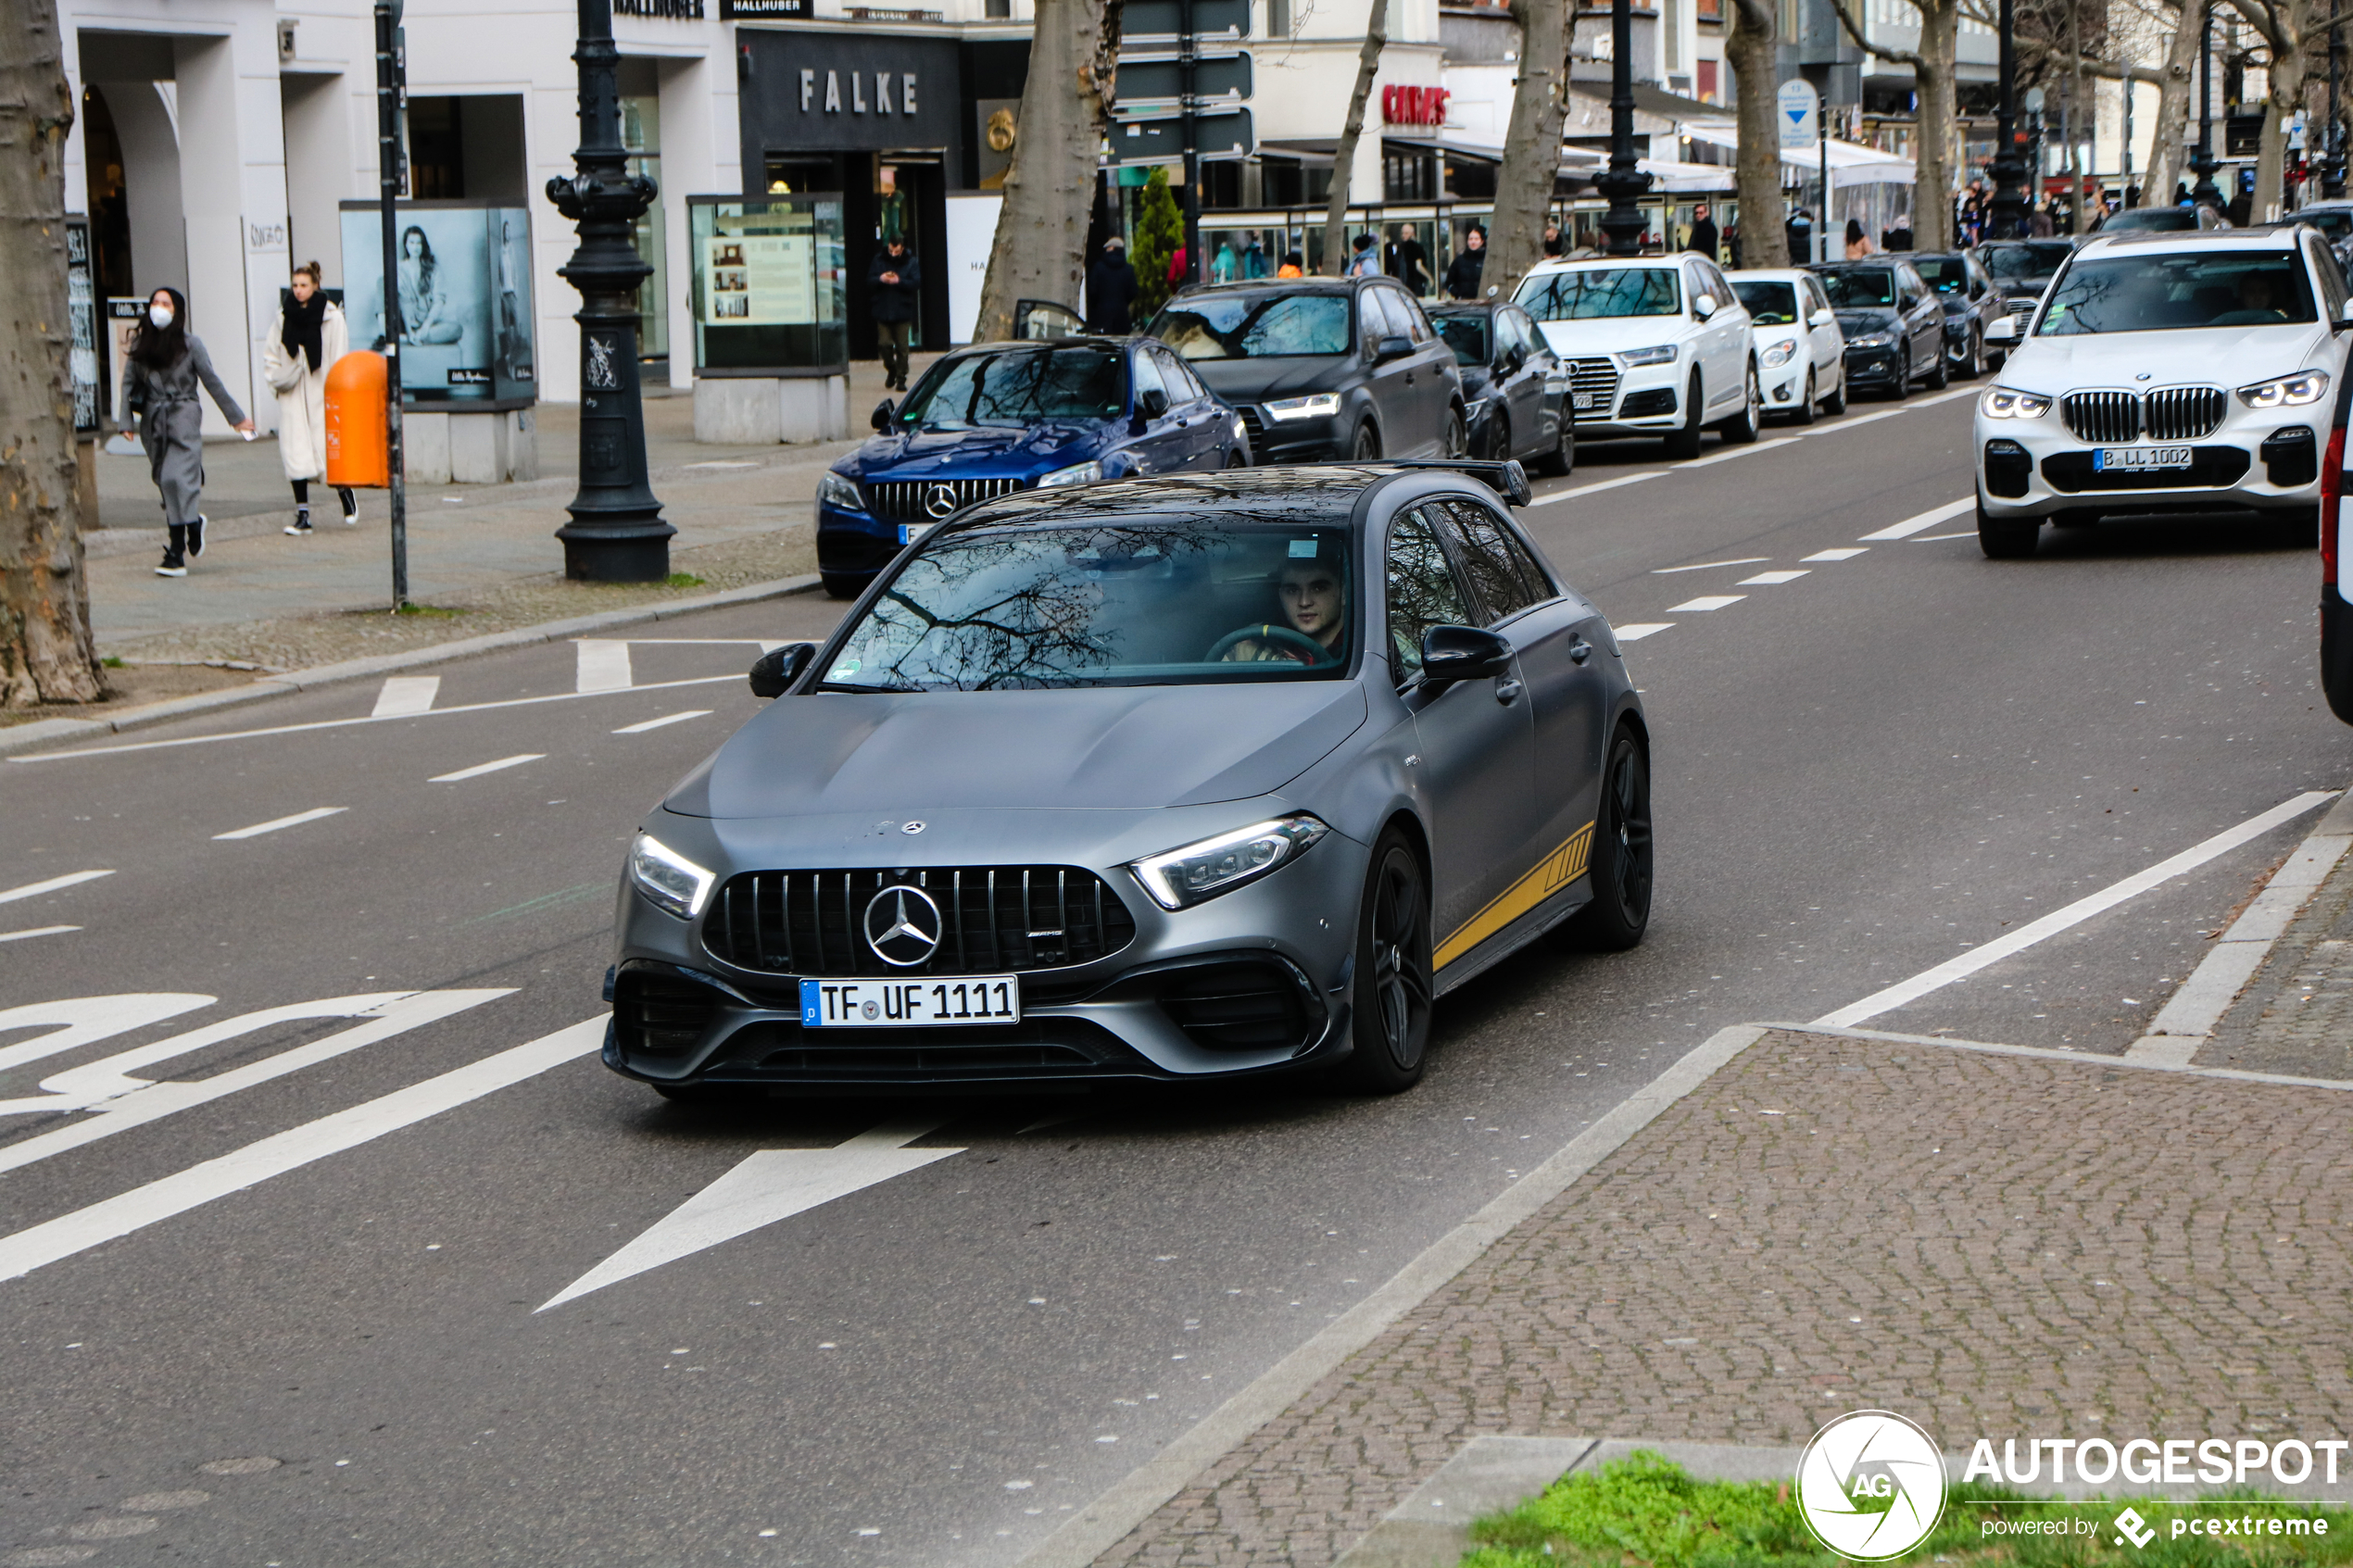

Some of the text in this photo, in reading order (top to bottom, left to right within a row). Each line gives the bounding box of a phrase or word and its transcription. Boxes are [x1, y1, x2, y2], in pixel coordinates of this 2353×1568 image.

[733, 0, 800, 11] HALLHUBER
[800, 69, 917, 114] FALKE
[2104, 448, 2190, 467] B LL 1002
[822, 983, 1013, 1021] TF UF 1111
[808, 1009, 815, 1018] D
